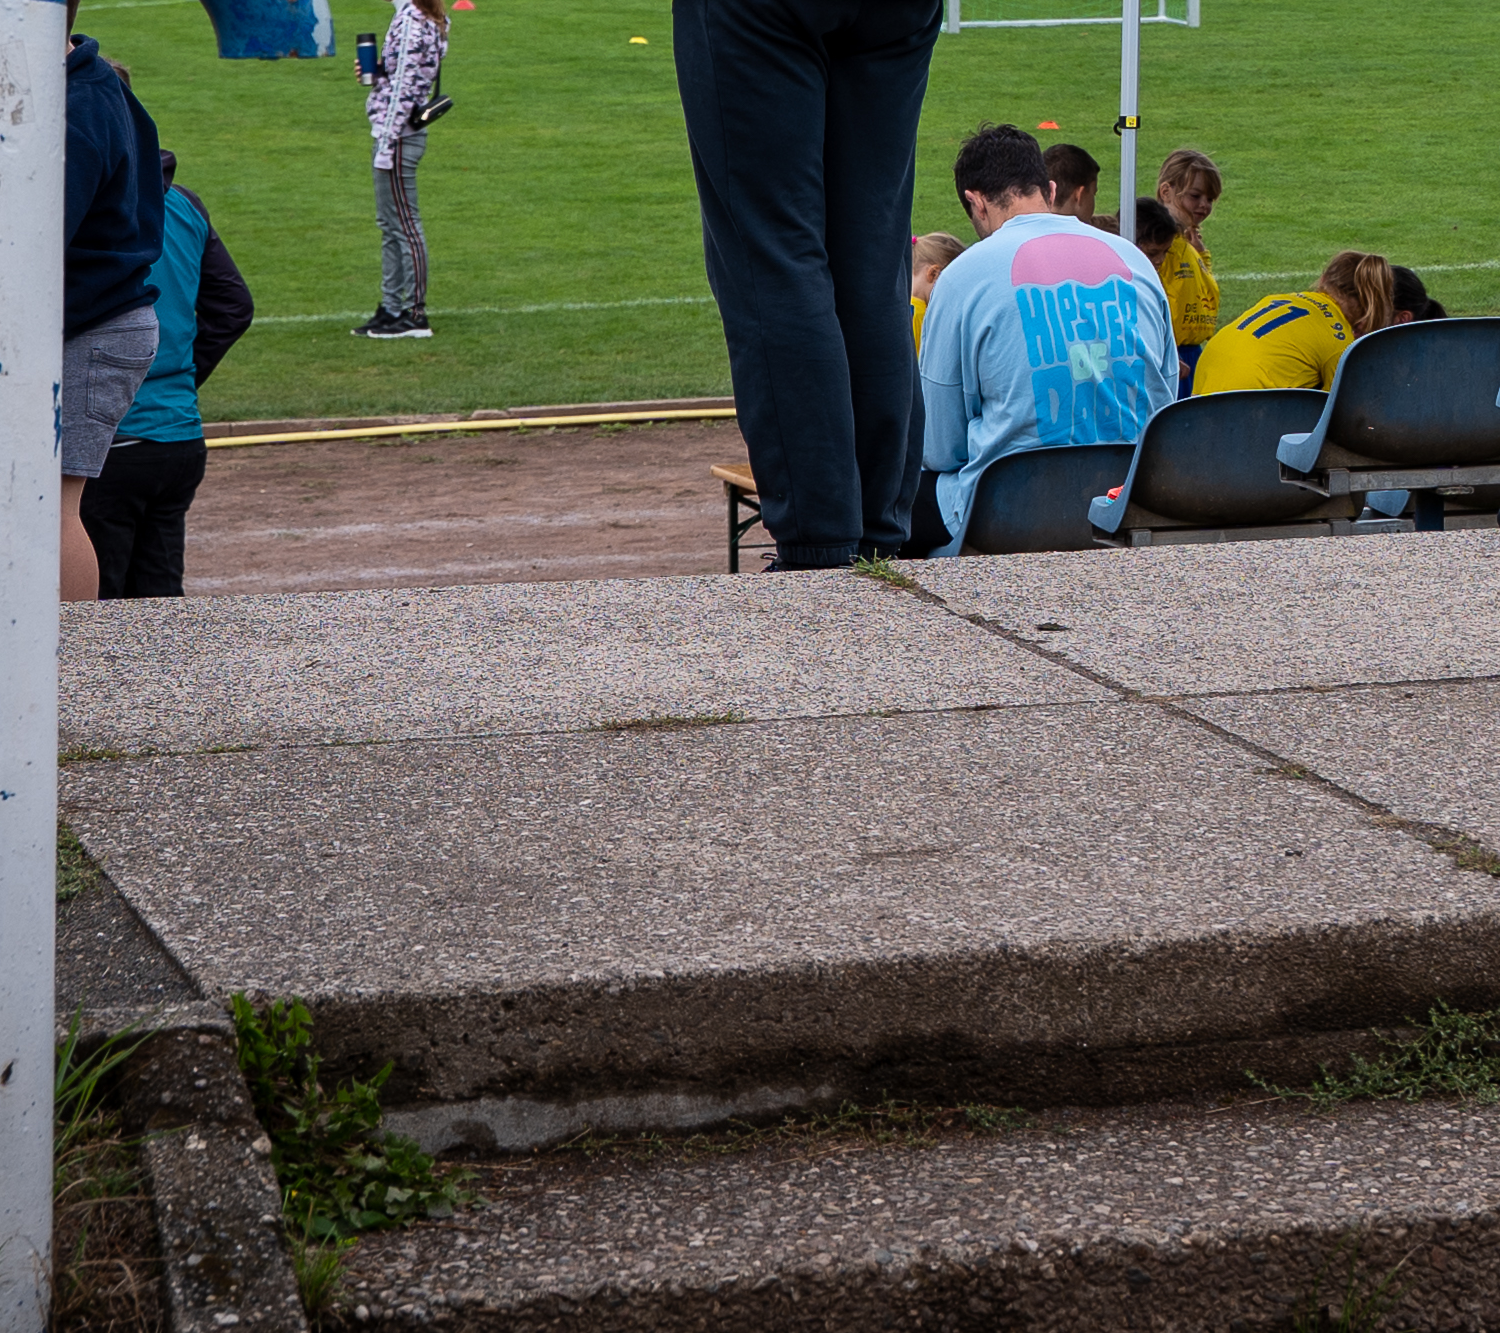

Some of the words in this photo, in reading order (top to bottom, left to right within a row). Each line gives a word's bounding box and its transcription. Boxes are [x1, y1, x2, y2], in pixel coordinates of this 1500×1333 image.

[1015, 279, 1146, 368] HIPSTER
[1237, 300, 1310, 339] 11
[1330, 322, 1346, 341] 99
[1031, 359, 1149, 445] DOOM
